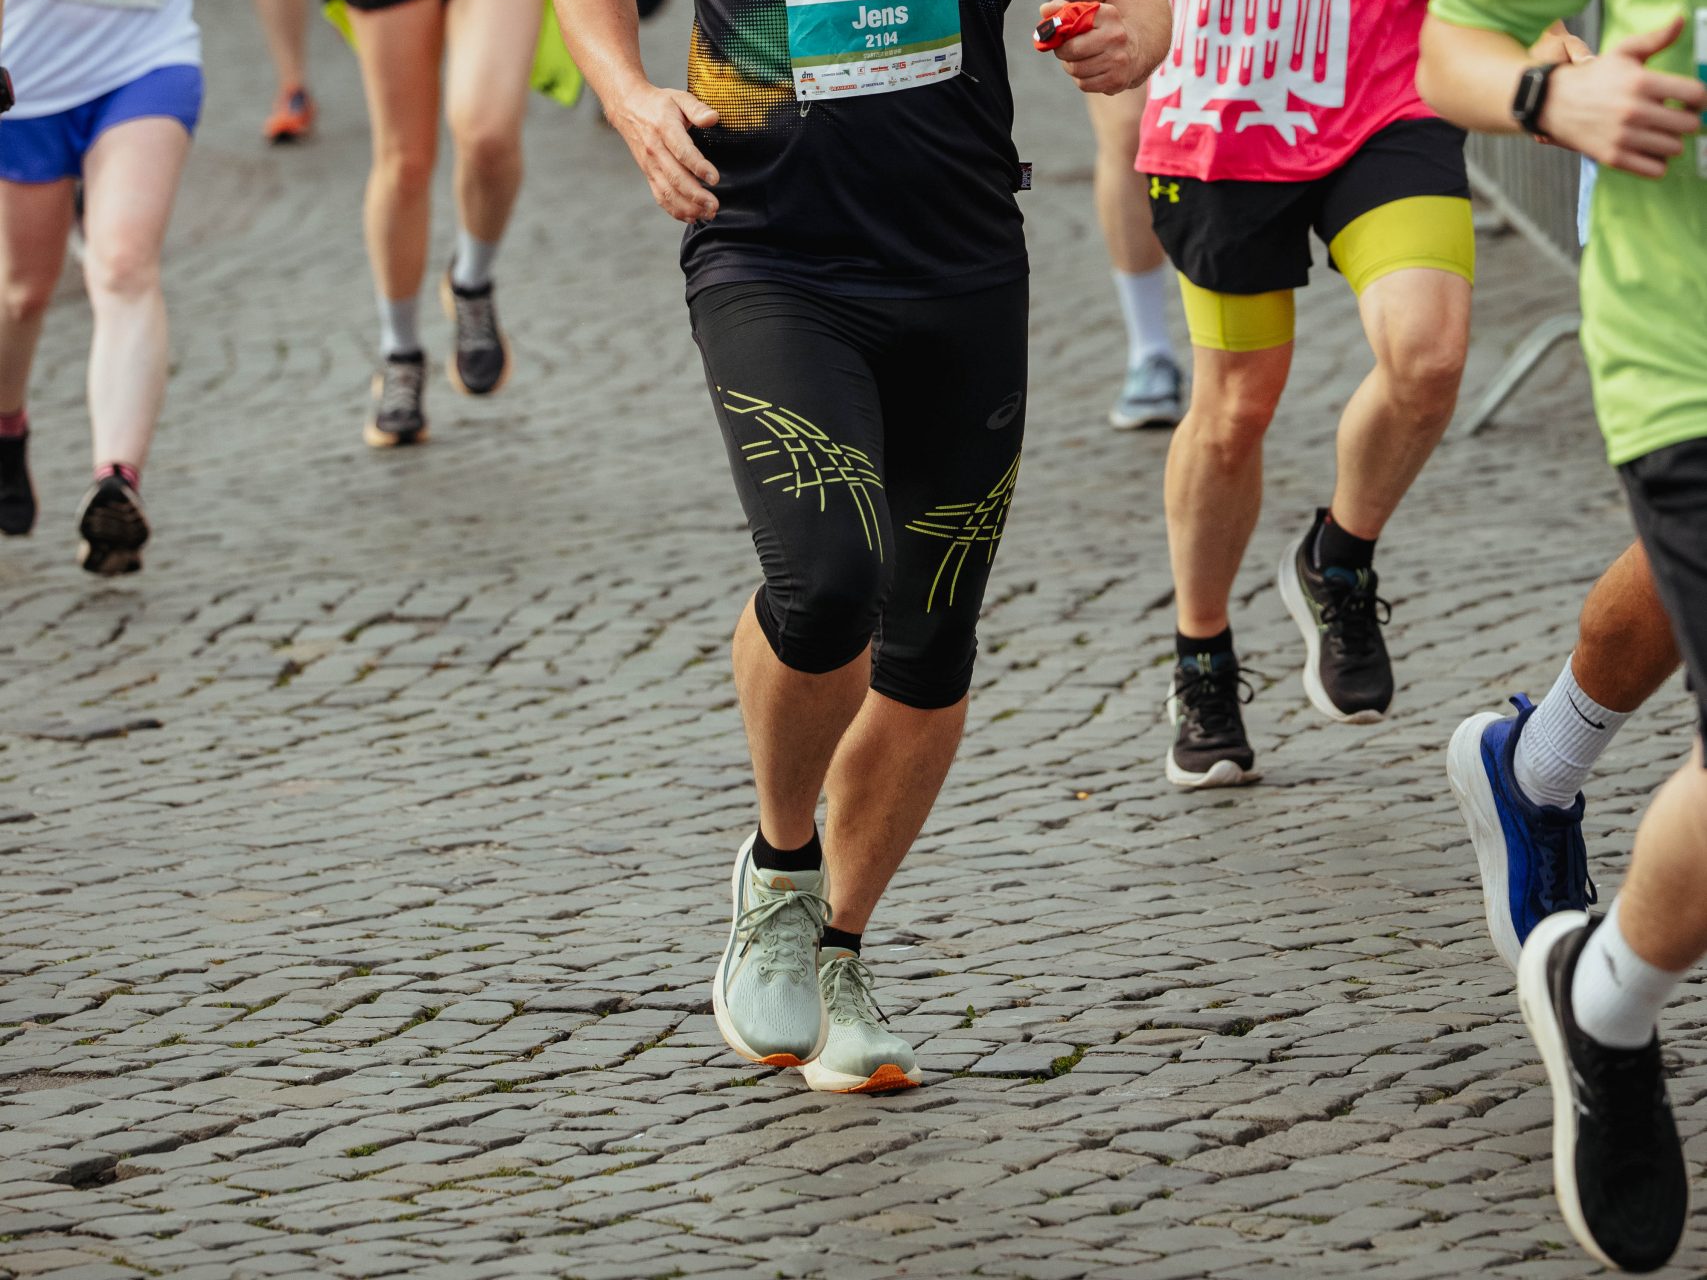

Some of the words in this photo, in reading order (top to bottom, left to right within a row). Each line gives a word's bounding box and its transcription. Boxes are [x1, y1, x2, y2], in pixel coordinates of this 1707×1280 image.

[851, 5, 909, 30] Jens
[865, 31, 898, 48] 2104
[801, 70, 814, 79] dm
